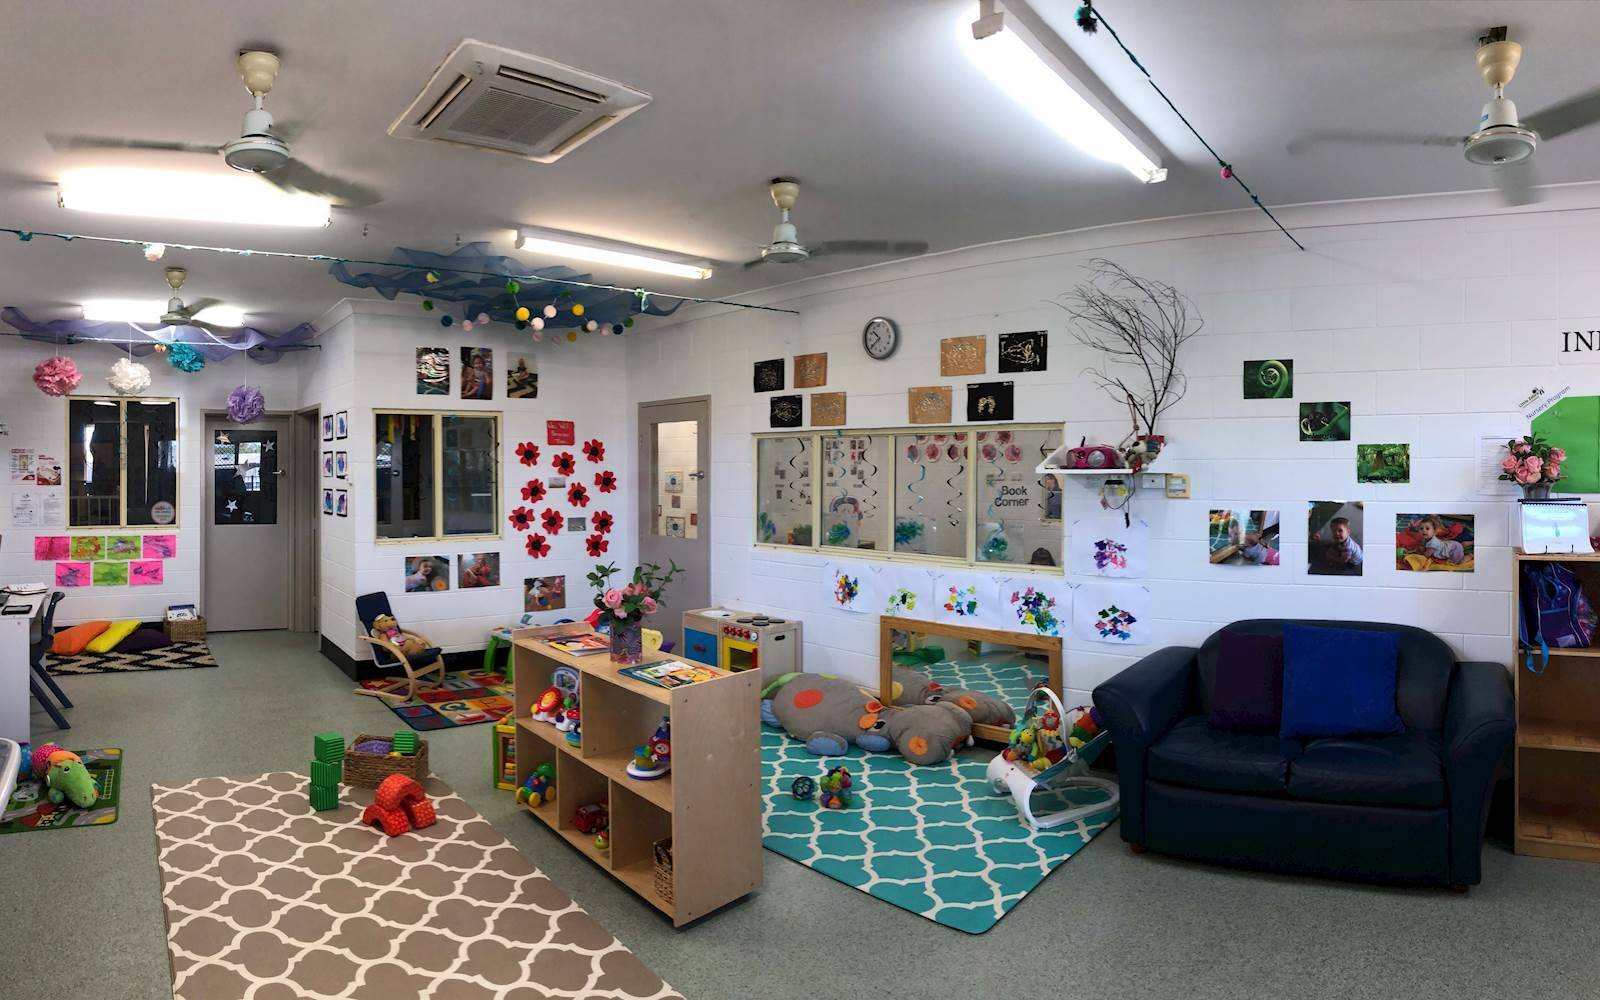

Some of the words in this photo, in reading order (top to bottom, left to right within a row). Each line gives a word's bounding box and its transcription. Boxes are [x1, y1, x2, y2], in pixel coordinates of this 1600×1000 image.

[1526, 403, 1547, 419] Nursery
[1547, 385, 1570, 404] Program
[1001, 485, 1027, 496] Book
[994, 497, 1029, 507] Corner
